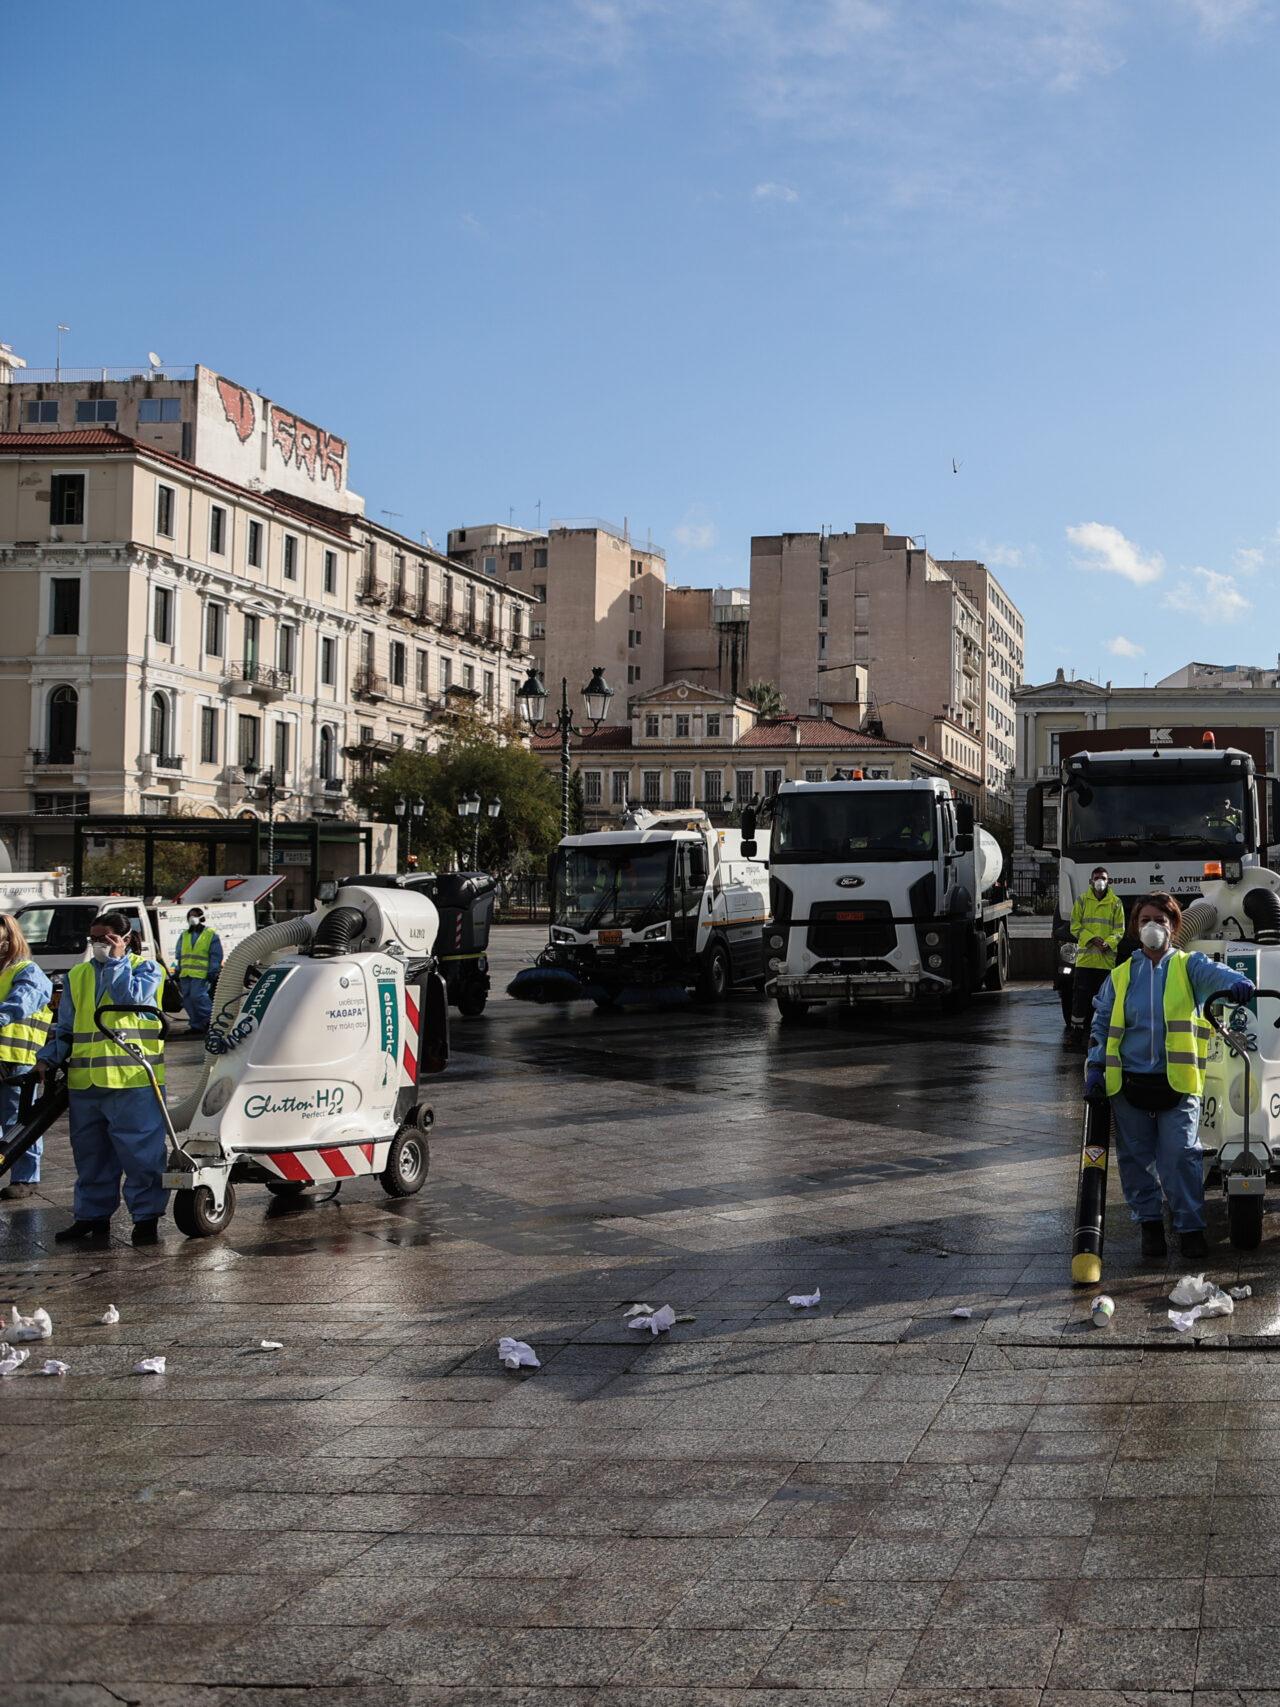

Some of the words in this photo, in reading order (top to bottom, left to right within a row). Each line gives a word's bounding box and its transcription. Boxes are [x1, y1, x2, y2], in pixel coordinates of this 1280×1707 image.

[248, 974, 277, 1015] electric
[384, 992, 395, 1053] electric
[244, 1094, 313, 1119] Glutton
[301, 1111, 326, 1119] Perfect
